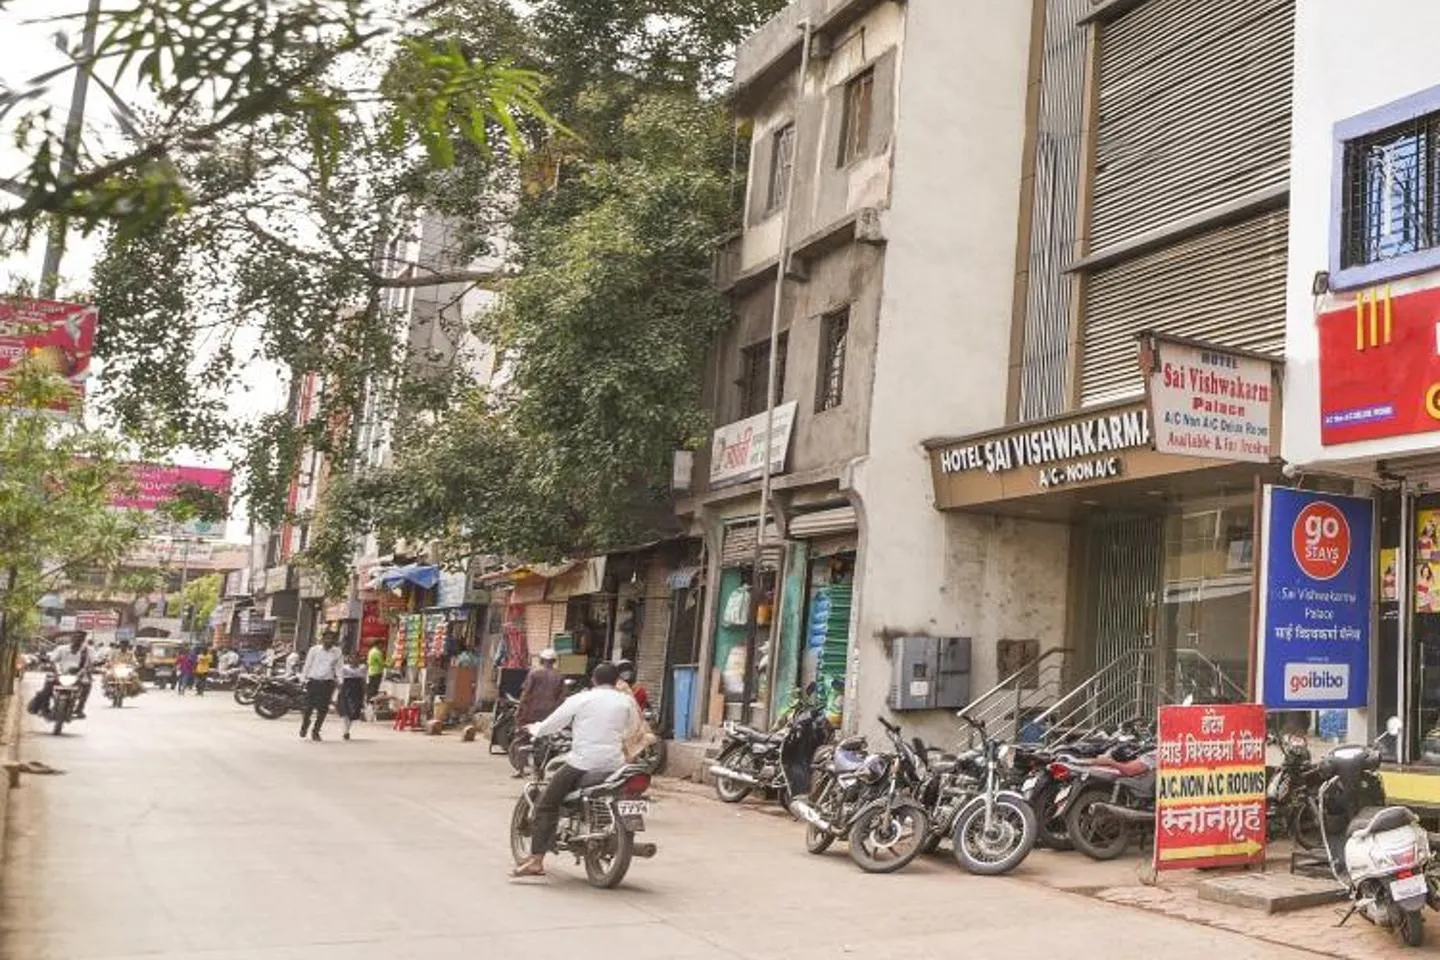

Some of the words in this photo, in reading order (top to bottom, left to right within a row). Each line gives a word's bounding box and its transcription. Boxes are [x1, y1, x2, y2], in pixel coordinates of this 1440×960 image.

[1164, 362, 1185, 389] Sai
[1189, 368, 1270, 402] Vishwakarm
[1193, 397, 1245, 417] Palace
[940, 444, 984, 473] HOTEL
[985, 437, 1013, 473] SAI
[1094, 456, 1118, 480] A/C
[1305, 514, 1339, 546] go
[1305, 546, 1339, 562] STAYS
[1305, 607, 1334, 620] Palace
[1290, 671, 1343, 693] goibibo
[1227, 771, 1265, 794] ROOMS
[1161, 803, 1262, 840] स्नानगृह
